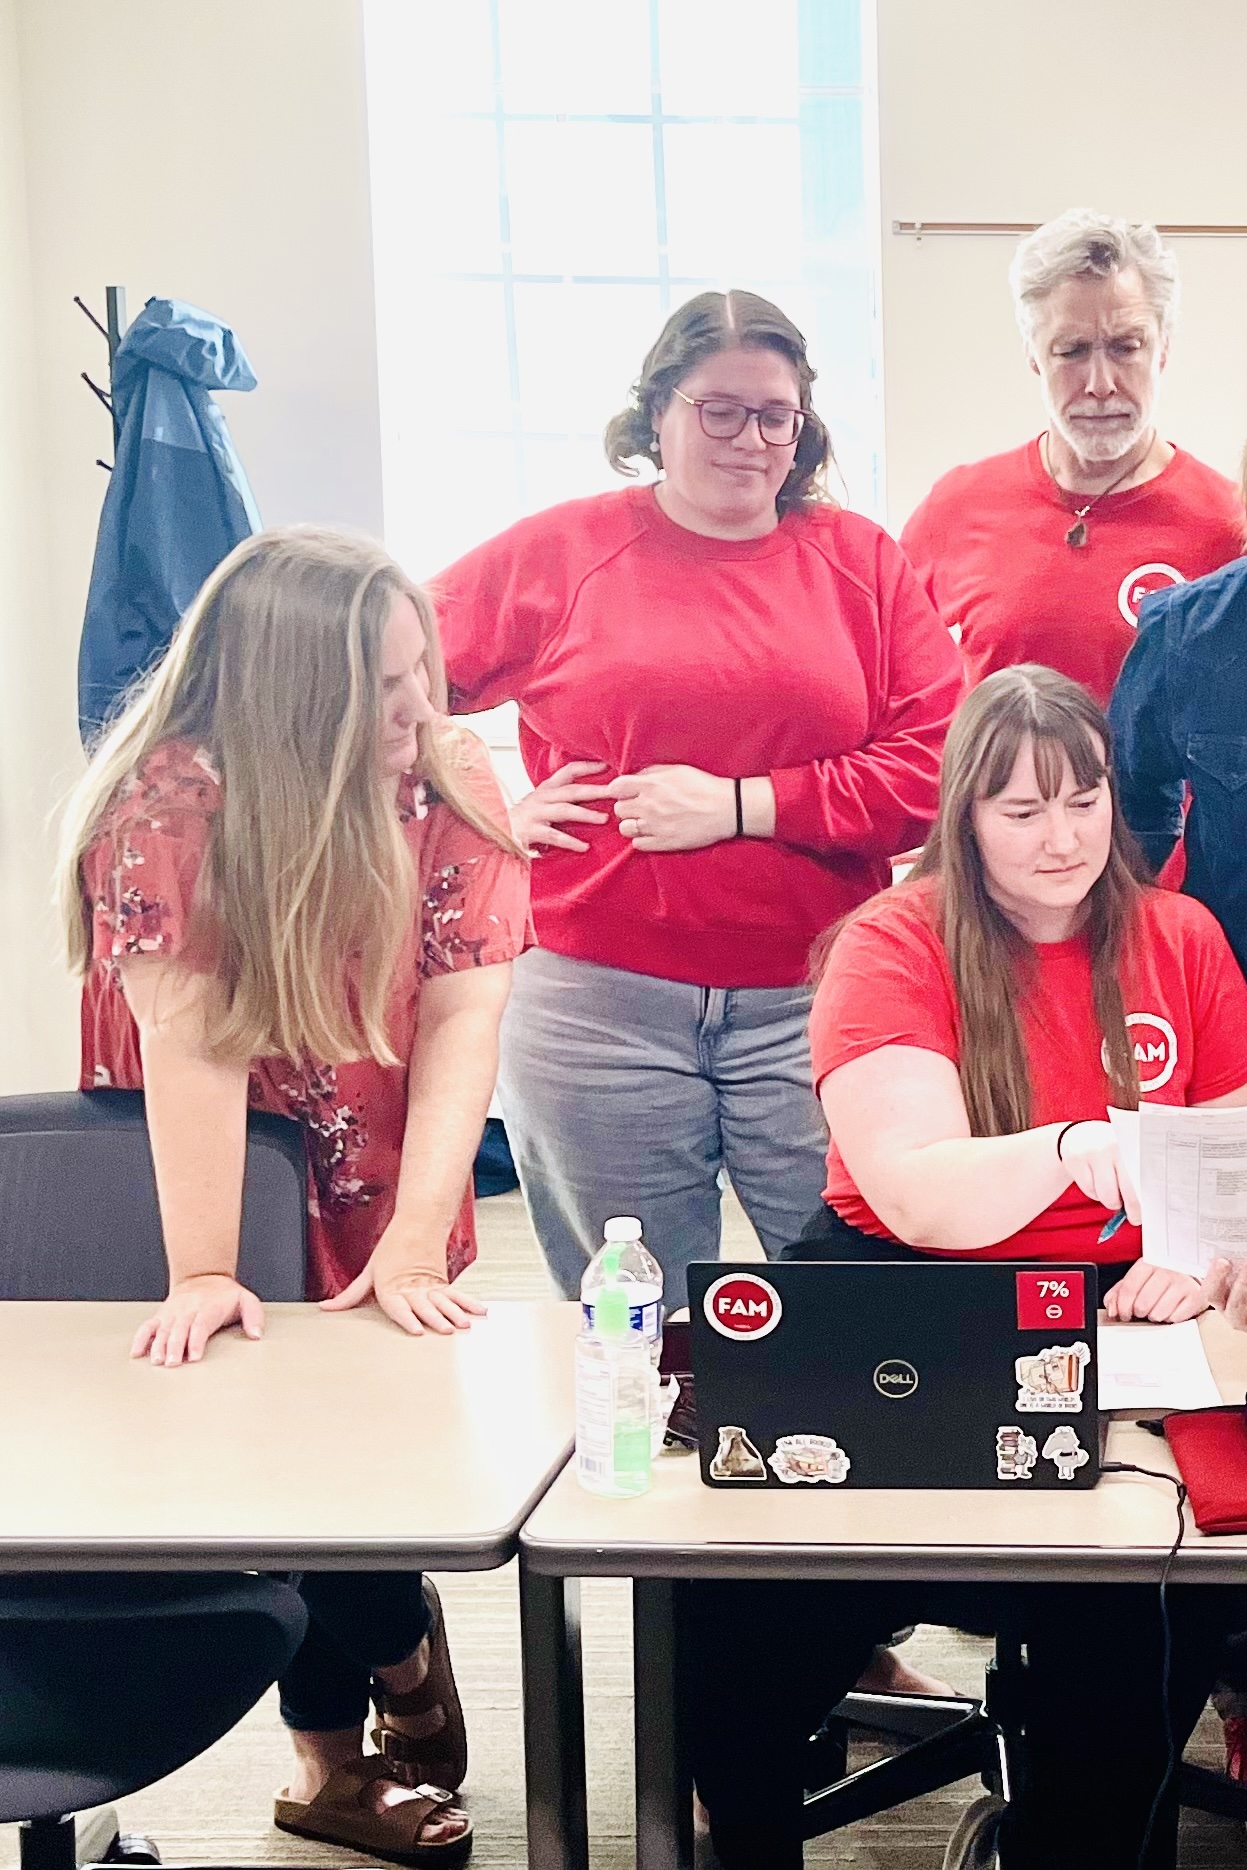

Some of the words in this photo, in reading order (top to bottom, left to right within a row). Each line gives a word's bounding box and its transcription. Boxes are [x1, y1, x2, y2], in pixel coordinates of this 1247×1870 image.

[1134, 1041, 1166, 1063] AM
[1036, 1280, 1070, 1298] 7%
[718, 1297, 768, 1318] FAM
[879, 1373, 914, 1384] DELL
